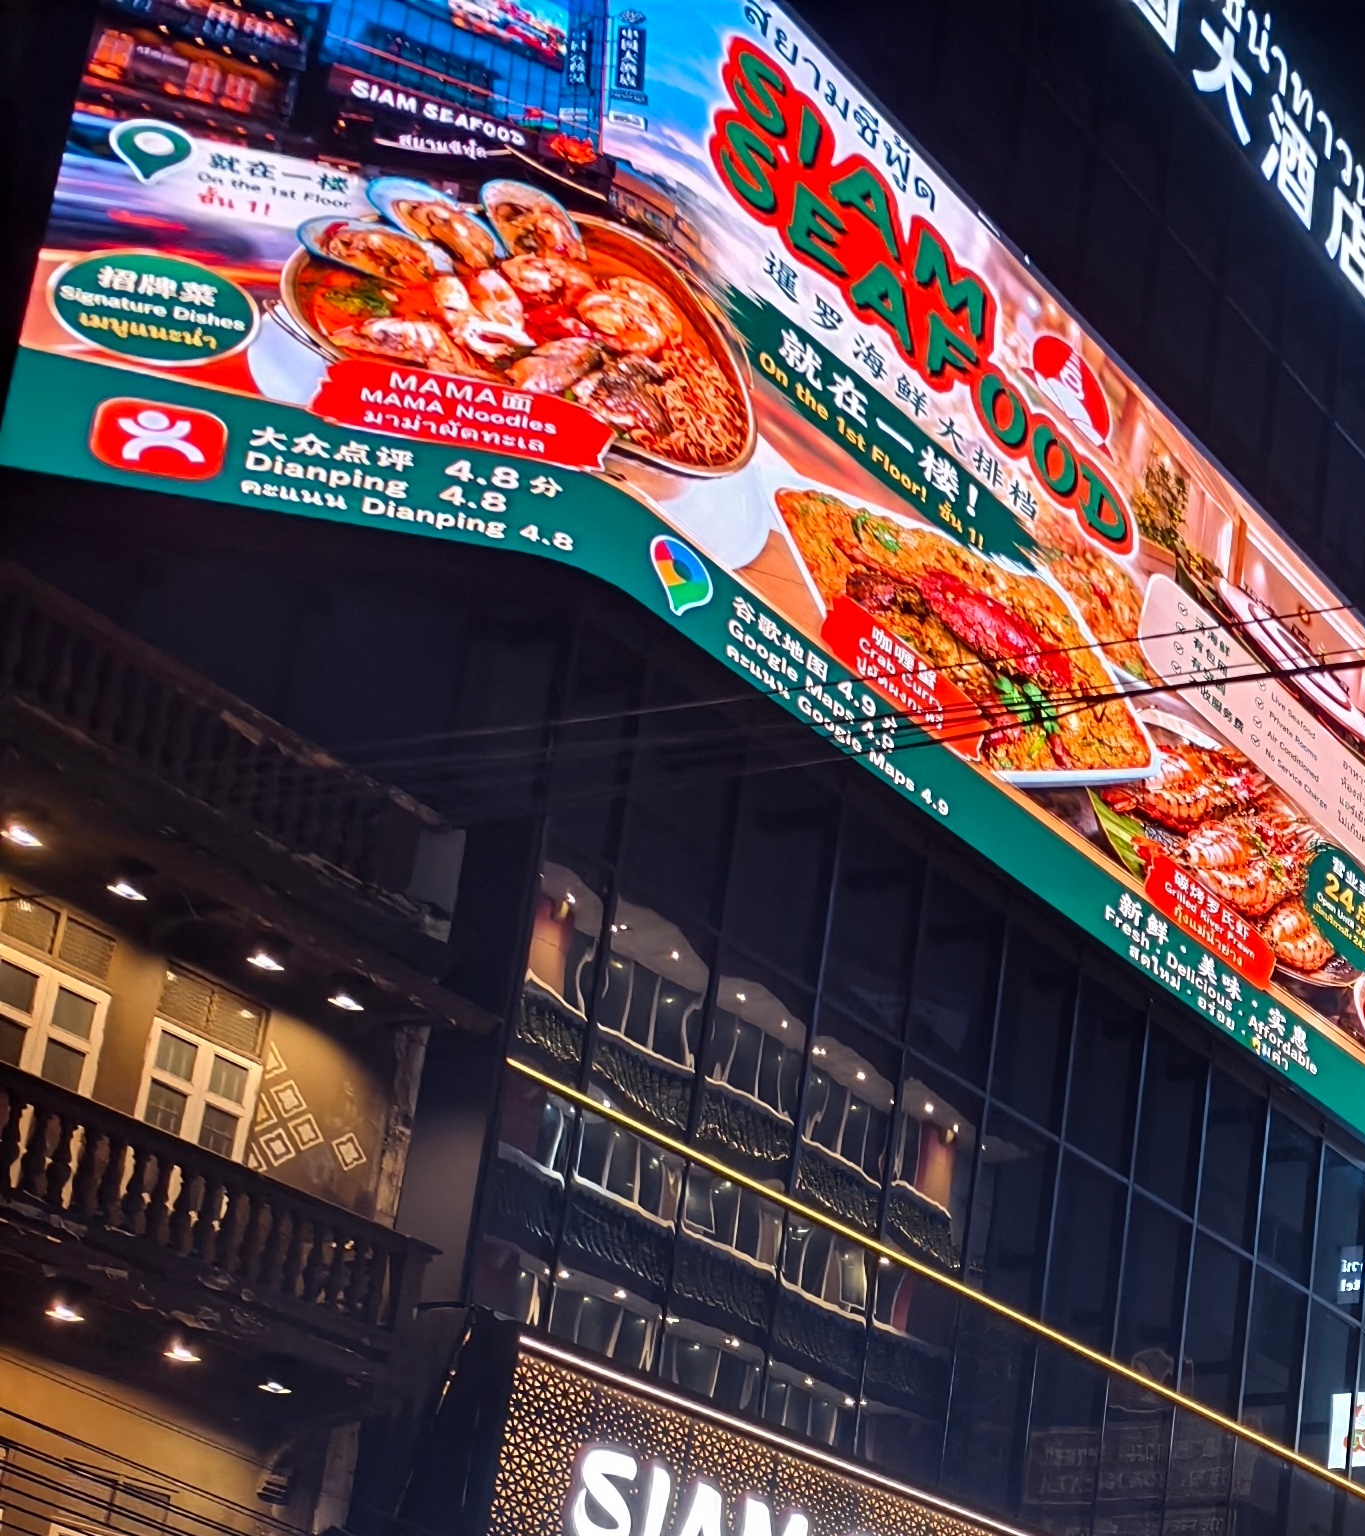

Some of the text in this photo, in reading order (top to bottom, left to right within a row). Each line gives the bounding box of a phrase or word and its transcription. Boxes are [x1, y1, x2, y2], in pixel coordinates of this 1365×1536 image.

[351, 79, 526, 146] SIAM SEAFOOD
[196, 170, 224, 186] On
[231, 176, 262, 193] the
[733, 51, 986, 341] SIAM
[59, 285, 247, 332] Signature Dishes
[97, 265, 218, 308] 招牌菜
[719, 119, 1128, 543] SEAFOOD
[360, 387, 558, 436] MAMA Noodles
[762, 249, 1039, 522] 暹罗海鲜大排档
[248, 425, 564, 498] 大众点评 4.8 分
[758, 351, 928, 504] On the 1st Floor!
[239, 479, 575, 552] คะแนน Dianping 4.8
[245, 450, 508, 513] Dianping 4.8
[727, 618, 856, 727] Google Maps
[732, 594, 877, 717] 谷歌地图 4.9
[858, 637, 897, 676] Crab
[796, 695, 863, 754] Google
[868, 749, 916, 794] Maps
[920, 787, 951, 818] 4.9
[1163, 881, 1257, 962] Grilled River Prawn
[1104, 904, 1319, 1077] Fresh Delicious Affordable
[1118, 892, 1310, 1054] 新鲜 美味 实惠
